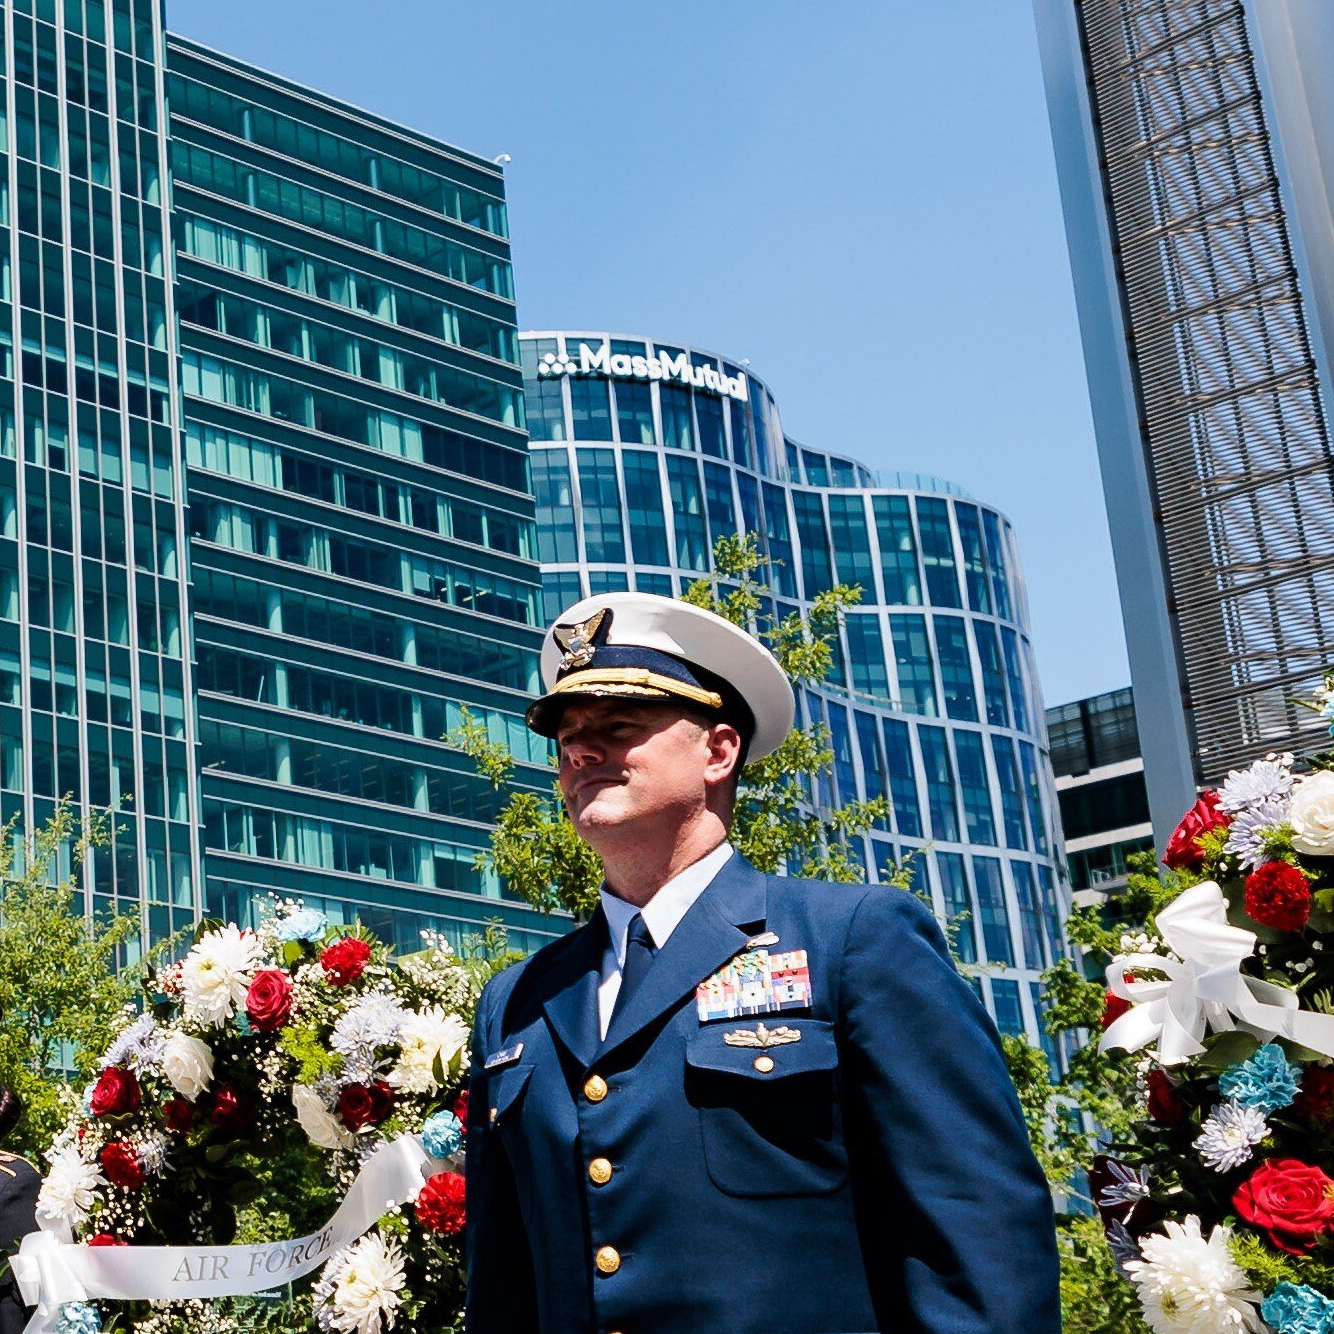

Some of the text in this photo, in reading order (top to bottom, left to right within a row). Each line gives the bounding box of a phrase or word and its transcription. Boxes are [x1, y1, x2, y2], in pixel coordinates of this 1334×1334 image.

[579, 343, 748, 402] MassMutual
[172, 1226, 334, 1282] AIR FORCE
